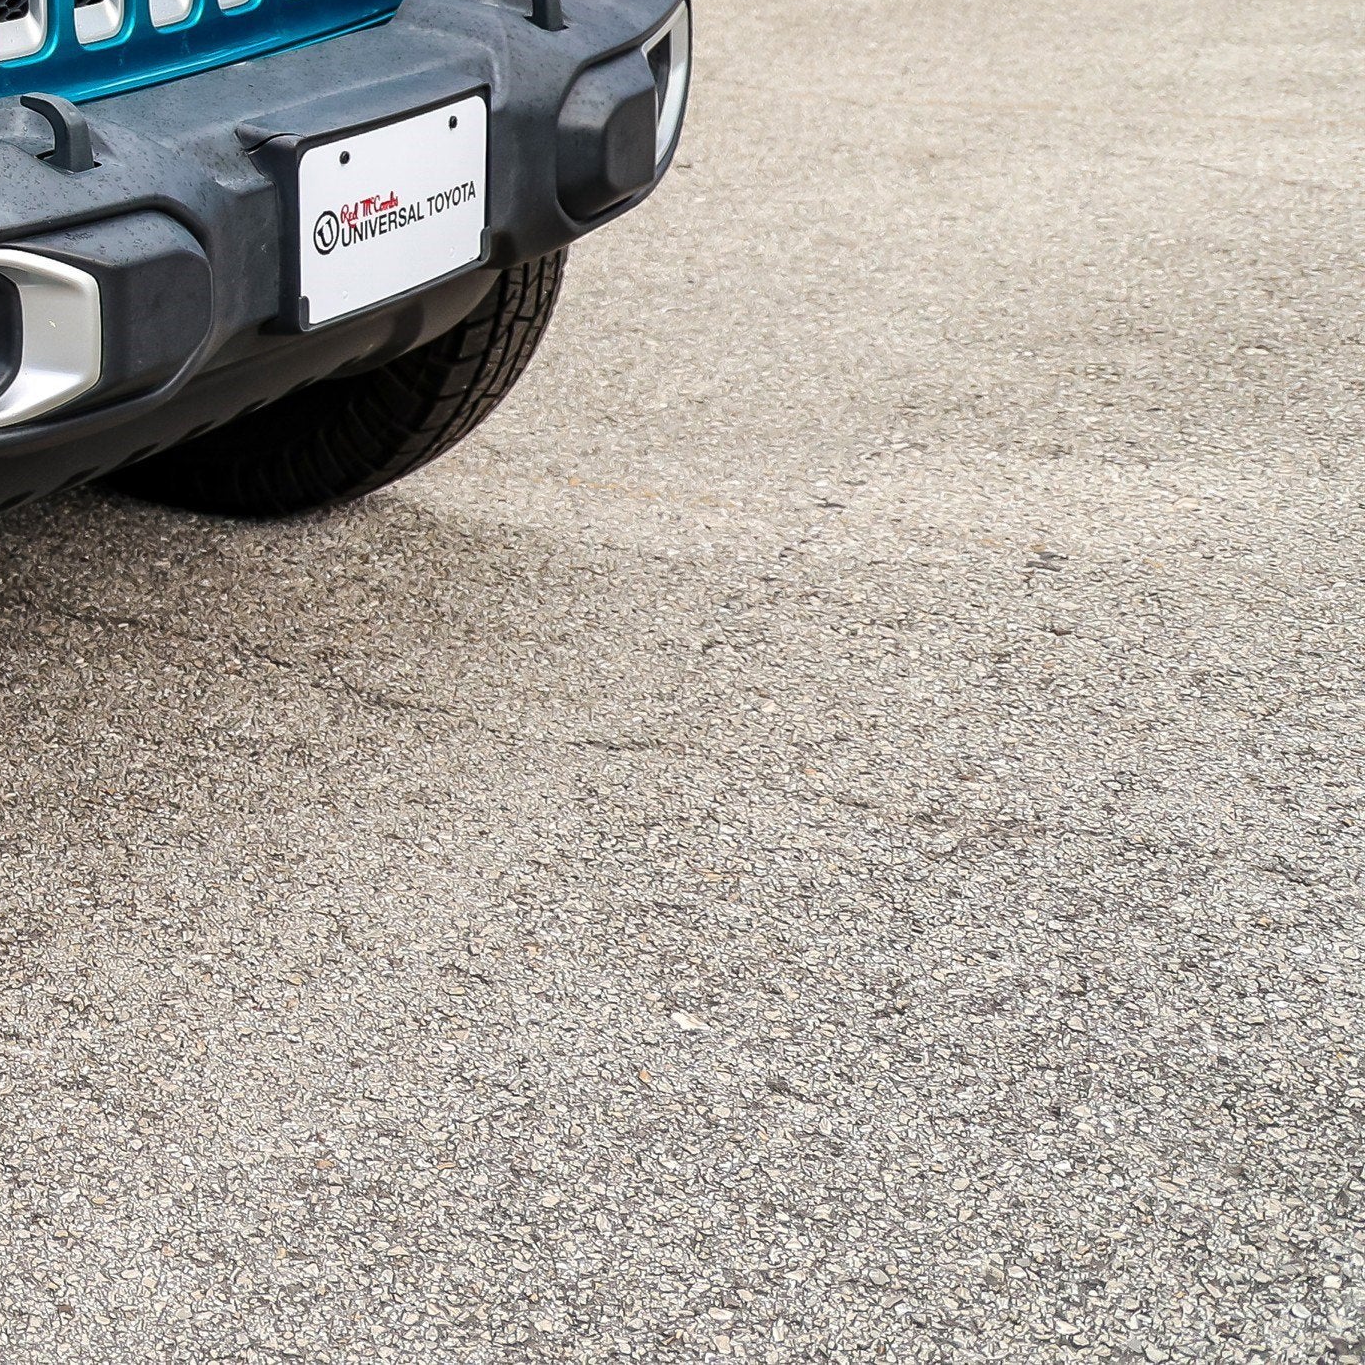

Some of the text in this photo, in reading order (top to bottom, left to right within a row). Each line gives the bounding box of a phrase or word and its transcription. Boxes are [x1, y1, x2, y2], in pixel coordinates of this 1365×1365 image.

[340, 202, 359, 228] Red
[341, 201, 425, 247] UNIVERSAL
[426, 181, 476, 216] TOYOTA
